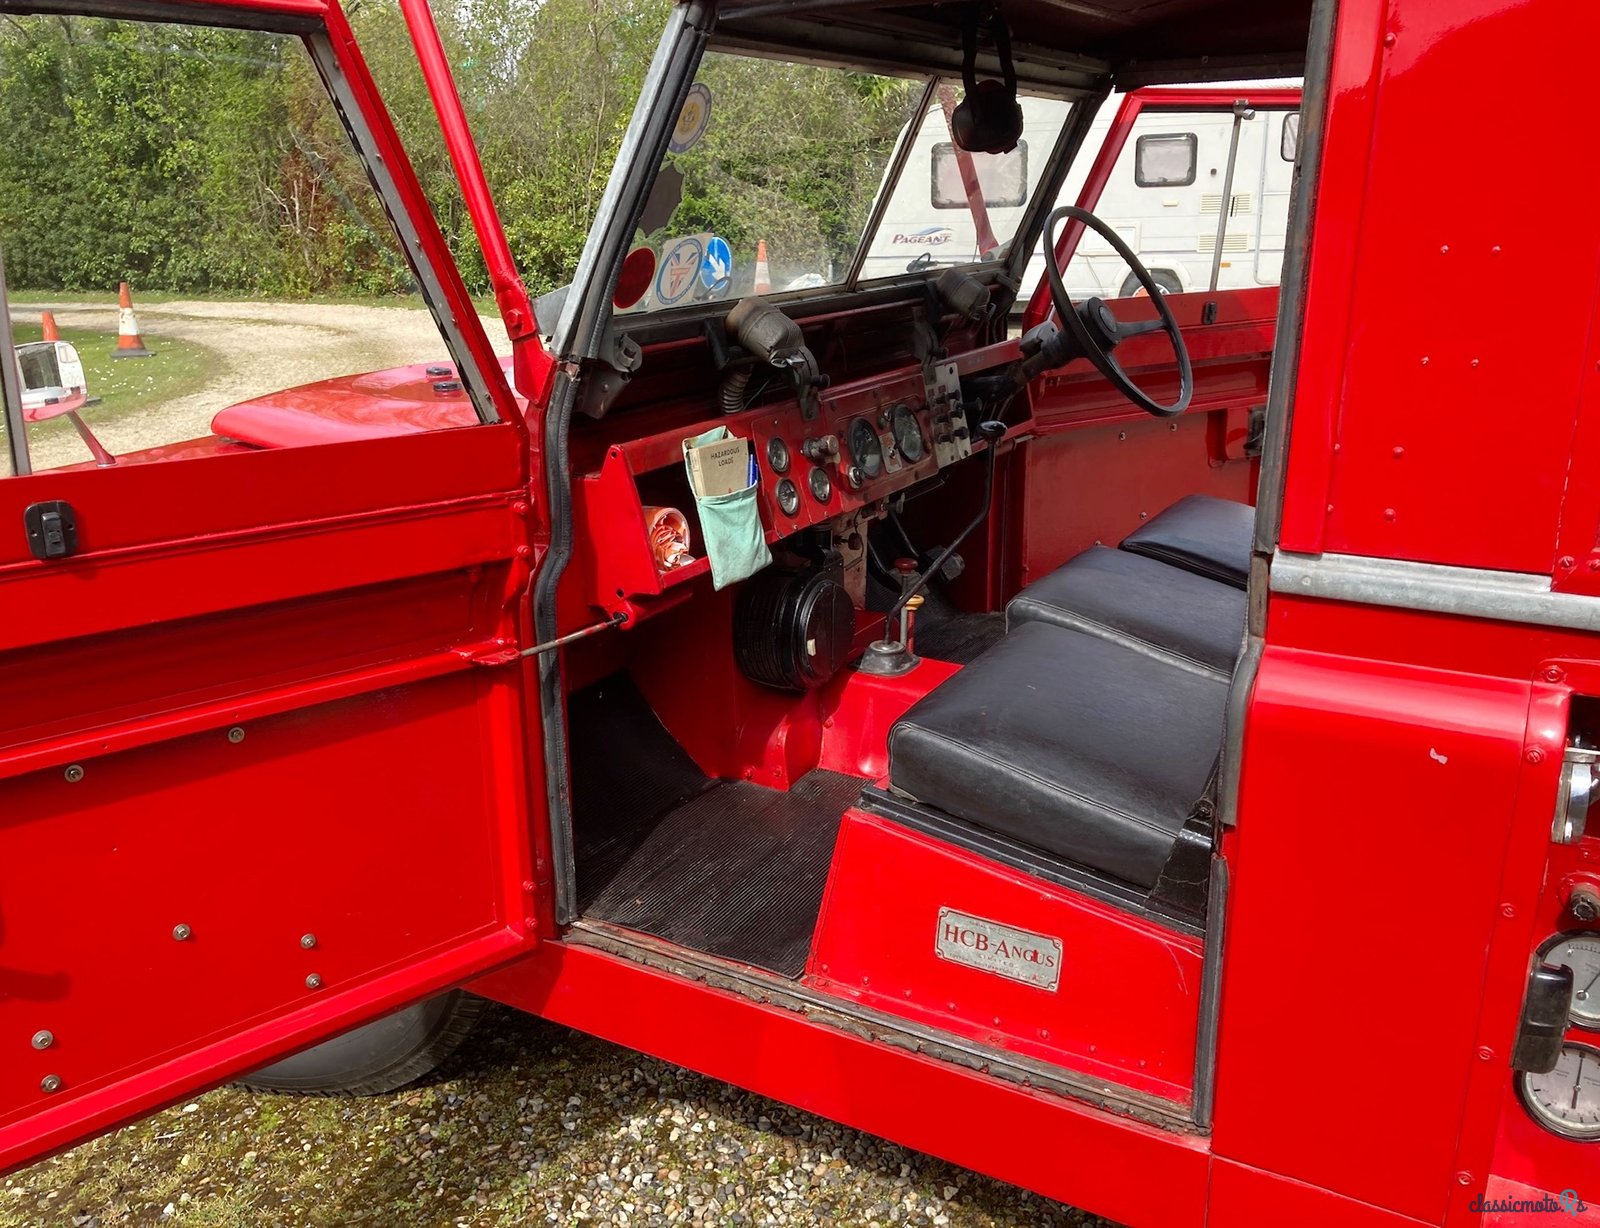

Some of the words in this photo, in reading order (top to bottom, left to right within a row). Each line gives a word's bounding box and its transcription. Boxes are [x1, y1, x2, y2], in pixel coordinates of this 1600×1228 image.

[892, 234, 951, 245] PAGEANT
[710, 446, 740, 460] HAZARDOUS
[718, 456, 734, 467] LOADS
